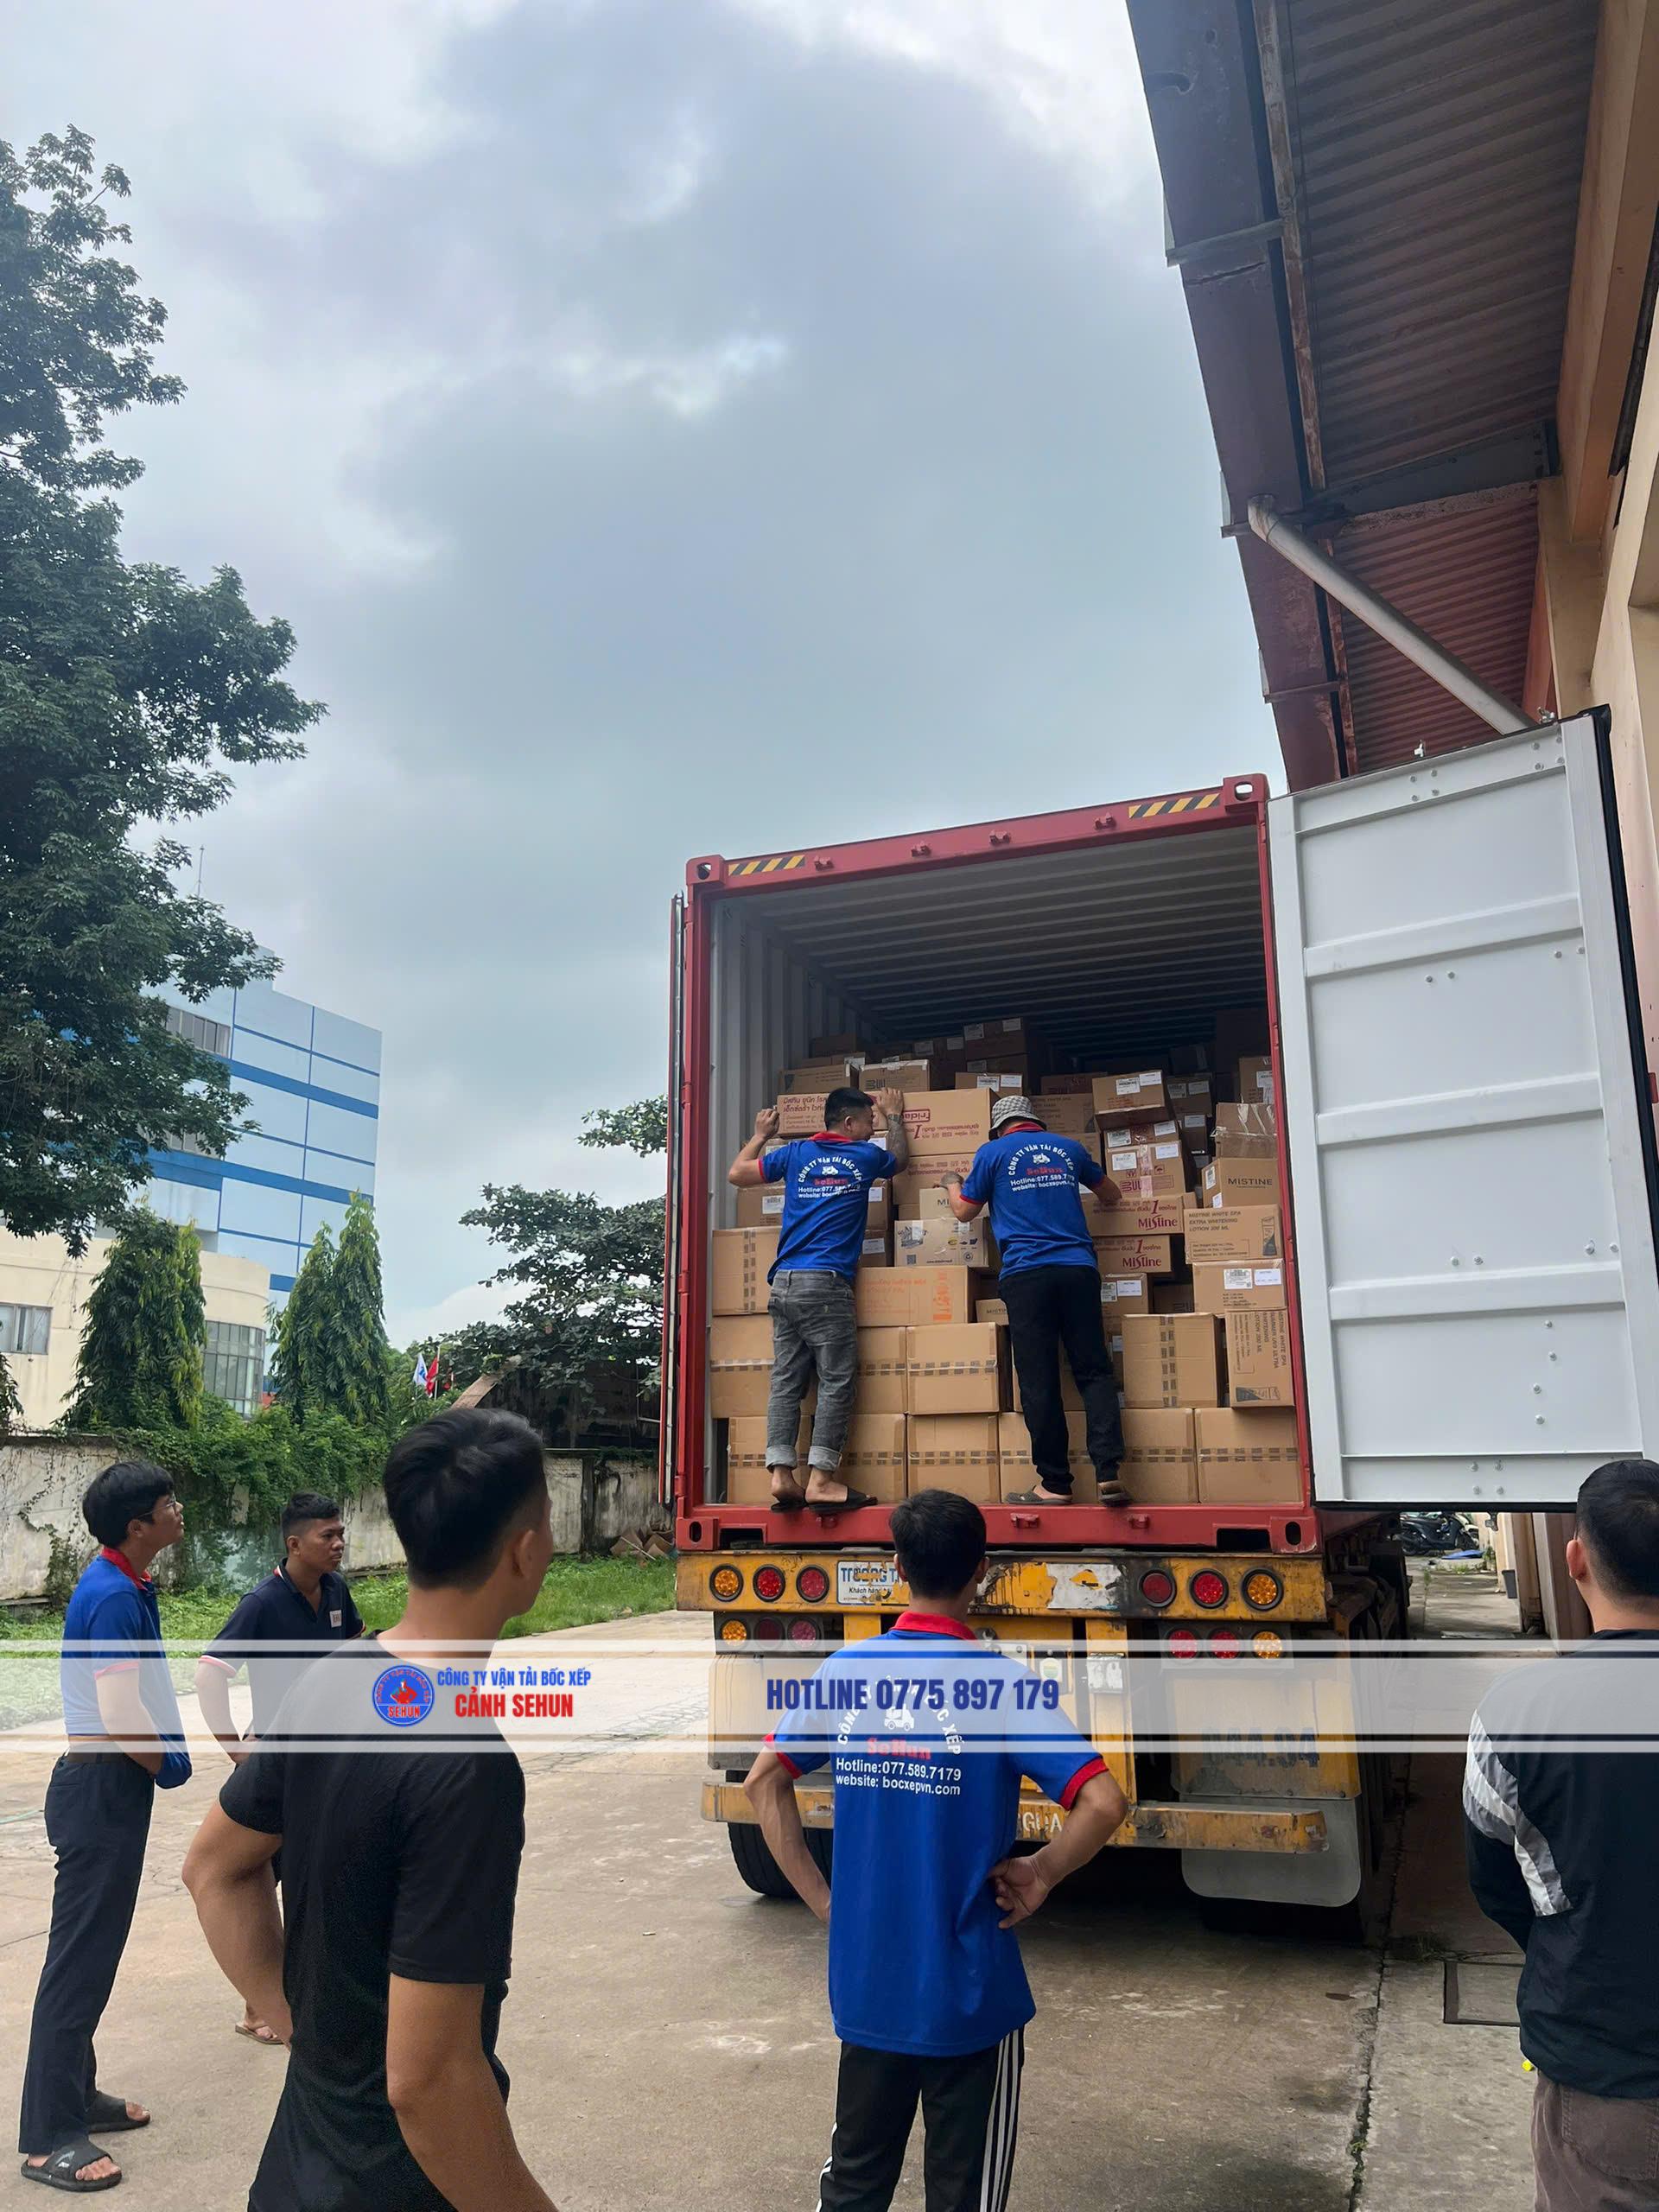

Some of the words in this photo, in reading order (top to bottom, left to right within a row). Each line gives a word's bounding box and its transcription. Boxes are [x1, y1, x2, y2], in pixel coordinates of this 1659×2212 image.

[809, 1160, 817, 1168] TY
[1151, 1199, 1159, 1214] 1
[1135, 1239, 1143, 1254] 1
[867, 1737, 931, 1760] SeHun
[836, 1774, 879, 1788] website:
[882, 1777, 961, 1795] bocxepvn.com
